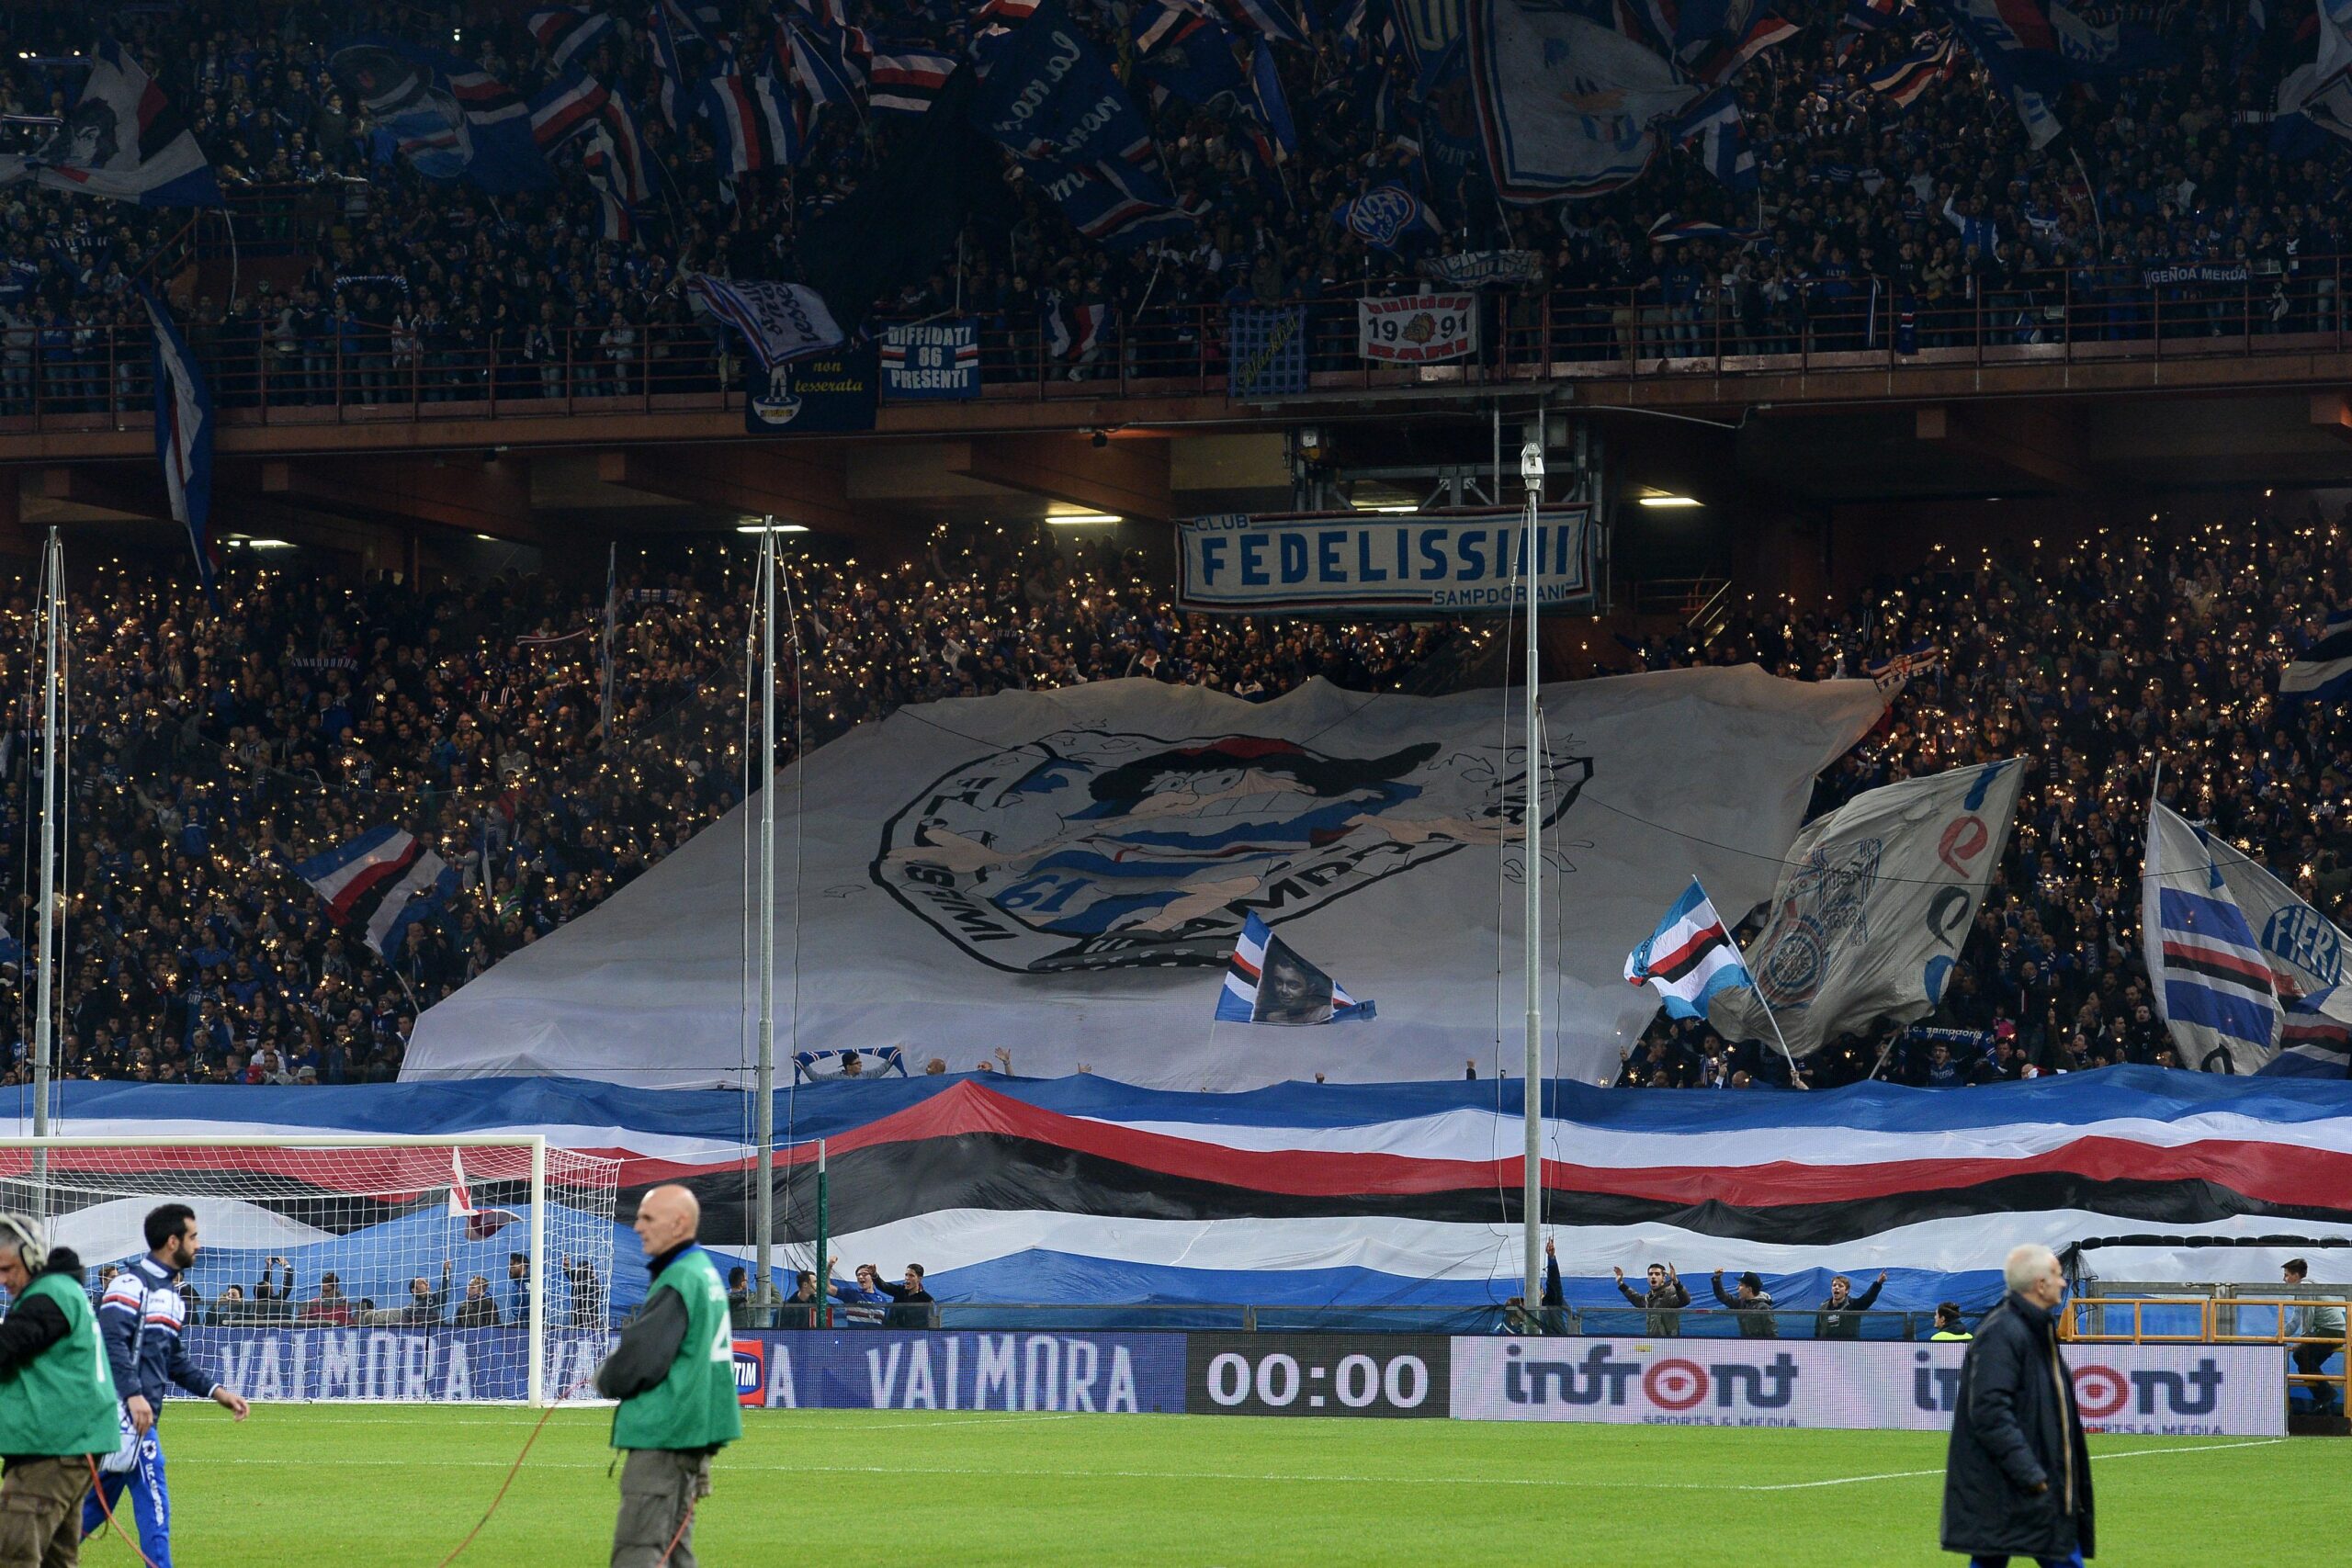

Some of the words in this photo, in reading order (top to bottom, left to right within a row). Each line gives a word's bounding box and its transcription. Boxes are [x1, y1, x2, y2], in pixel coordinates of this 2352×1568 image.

[2151, 267, 2197, 283] GENOA
[2201, 267, 2247, 281] MERDA
[888, 326, 971, 345] DIFFIDATI
[919, 346, 942, 367] 86
[1367, 337, 1468, 359] BARI
[812, 360, 843, 373] non
[794, 378, 865, 393] tesserata
[891, 369, 968, 389] PRESENTI
[1195, 514, 1248, 531] CLUB
[1434, 583, 1566, 606] SAMPDORANI
[734, 1362, 756, 1387] TIM
[1207, 1353, 1429, 1408] 00:00
[1506, 1344, 1799, 1410] infront
